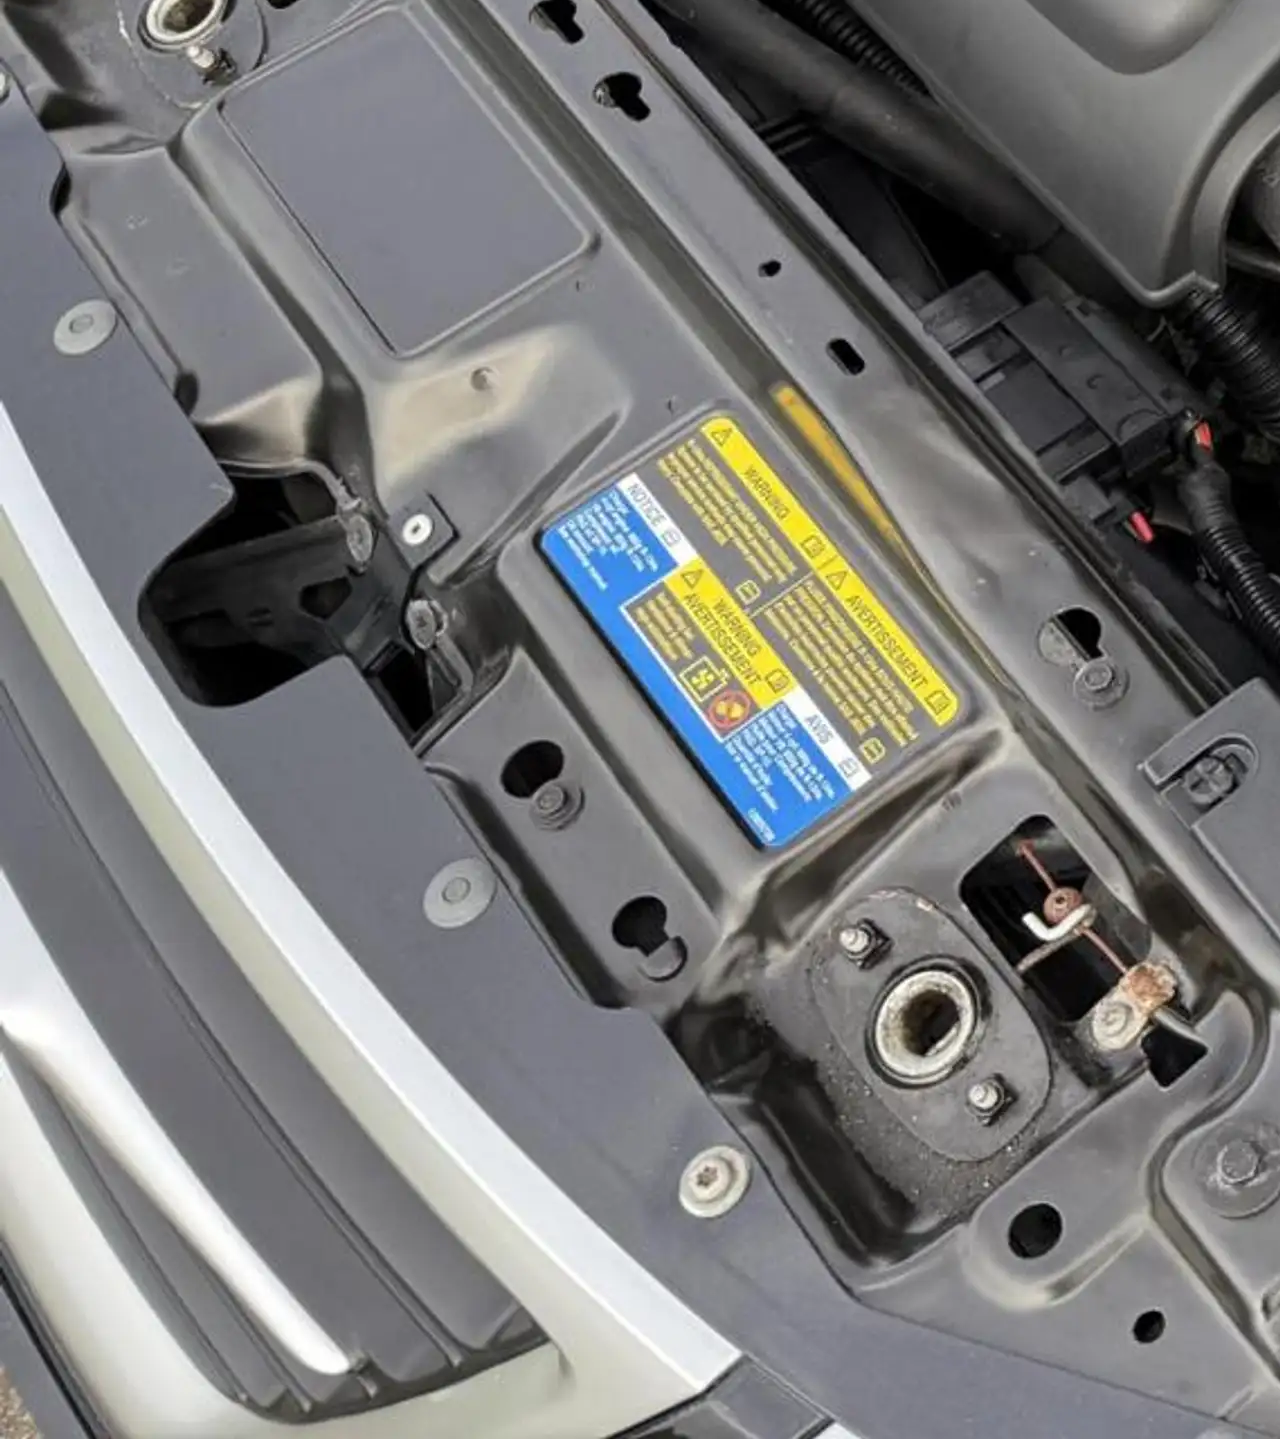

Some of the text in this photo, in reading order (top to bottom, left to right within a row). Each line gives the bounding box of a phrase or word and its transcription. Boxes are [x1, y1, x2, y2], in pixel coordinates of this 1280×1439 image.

[626, 482, 667, 535] NOTICE
[743, 467, 791, 521] WARNING
[683, 592, 763, 687] AVERTISSEMENT
[712, 598, 762, 658] WARNING
[844, 594, 929, 690] AVERTISSEMENT
[804, 713, 834, 746] AVIS
